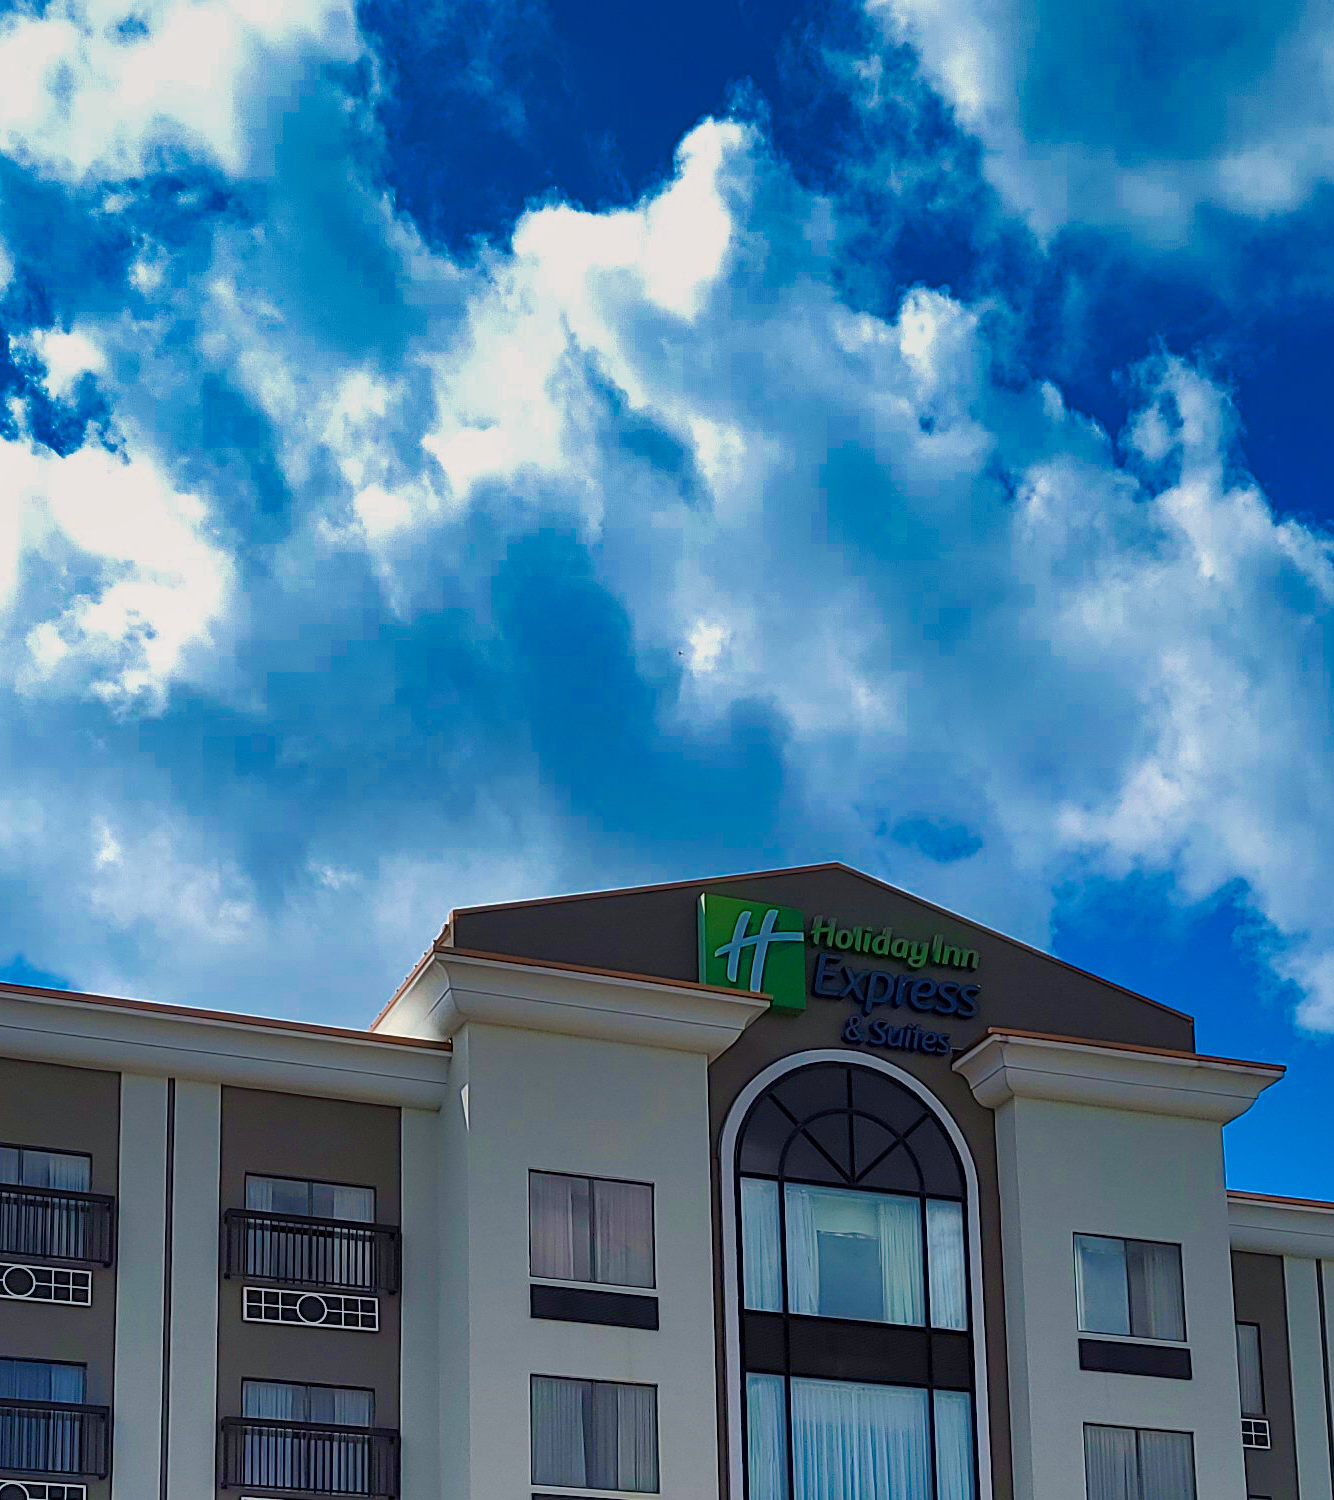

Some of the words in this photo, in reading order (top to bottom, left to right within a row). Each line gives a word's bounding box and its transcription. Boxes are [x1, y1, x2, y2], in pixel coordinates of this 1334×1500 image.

[811, 915, 930, 968] Holiday
[932, 934, 981, 970] Inn
[812, 952, 982, 1019] Express
[841, 1014, 864, 1044] &
[867, 1017, 952, 1055] Suites
